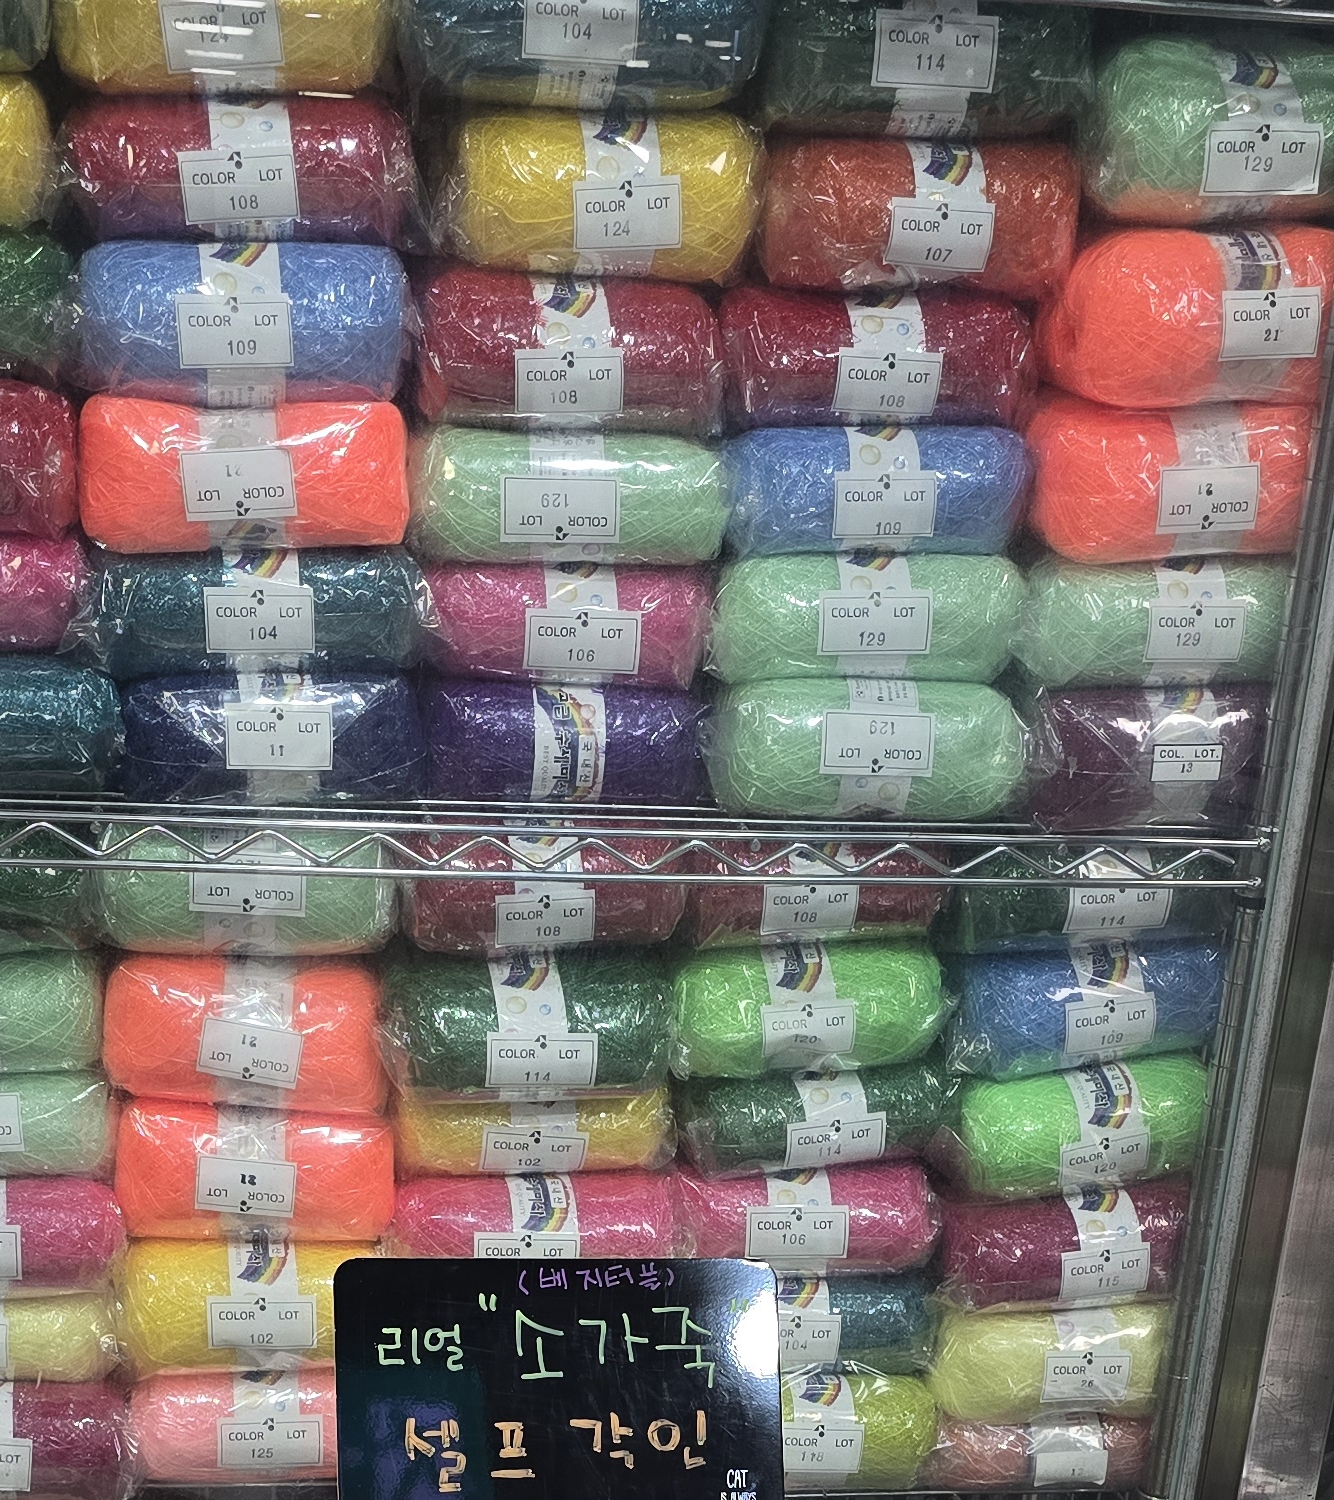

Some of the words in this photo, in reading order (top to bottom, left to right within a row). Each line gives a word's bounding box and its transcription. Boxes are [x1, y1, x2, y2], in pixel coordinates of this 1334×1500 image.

[533, 2, 579, 19] COLOR
[602, 7, 626, 21] LOT
[563, 21, 594, 40] 104
[889, 28, 929, 45] COLOR
[956, 34, 982, 47] LOT
[917, 54, 945, 71] 114
[1217, 141, 1255, 153] COLOR
[1282, 142, 1306, 153] LOT
[1245, 155, 1273, 172] 129
[188, 315, 231, 327] COLOR
[255, 315, 278, 326] LOT
[228, 340, 256, 356] 109
[848, 368, 887, 381] COLOR
[908, 372, 930, 383] LOT
[879, 394, 905, 408] 108
[216, 607, 257, 618] COLOR
[279, 607, 302, 618] LOT
[1159, 617, 1195, 628] COLOR
[1215, 618, 1236, 628] LOT
[250, 626, 277, 640] 104
[538, 626, 576, 637] COLOR
[601, 628, 623, 639] LOT
[1177, 632, 1201, 647] 129
[568, 648, 595, 662] 106
[773, 895, 809, 909] COLOR
[828, 893, 849, 903] LOT
[794, 911, 817, 925] 108
[499, 1049, 535, 1058] COLOR
[559, 1050, 580, 1059] LOT
[525, 1071, 551, 1082] 114
[758, 1221, 791, 1230] COLOR
[814, 1221, 833, 1229] LOT
[782, 1234, 806, 1245] 106
[1071, 1264, 1104, 1276] COLOR
[1122, 1259, 1141, 1269] LOT
[1097, 1275, 1120, 1288] 115
[375, 1324, 465, 1371] 리얼
[229, 1432, 264, 1441] COLOR
[287, 1430, 307, 1439] LOT
[251, 1448, 273, 1458] 125
[404, 1417, 537, 1492] 셀프
[569, 1410, 708, 1469] 각인
[726, 1469, 748, 1488] CAT
